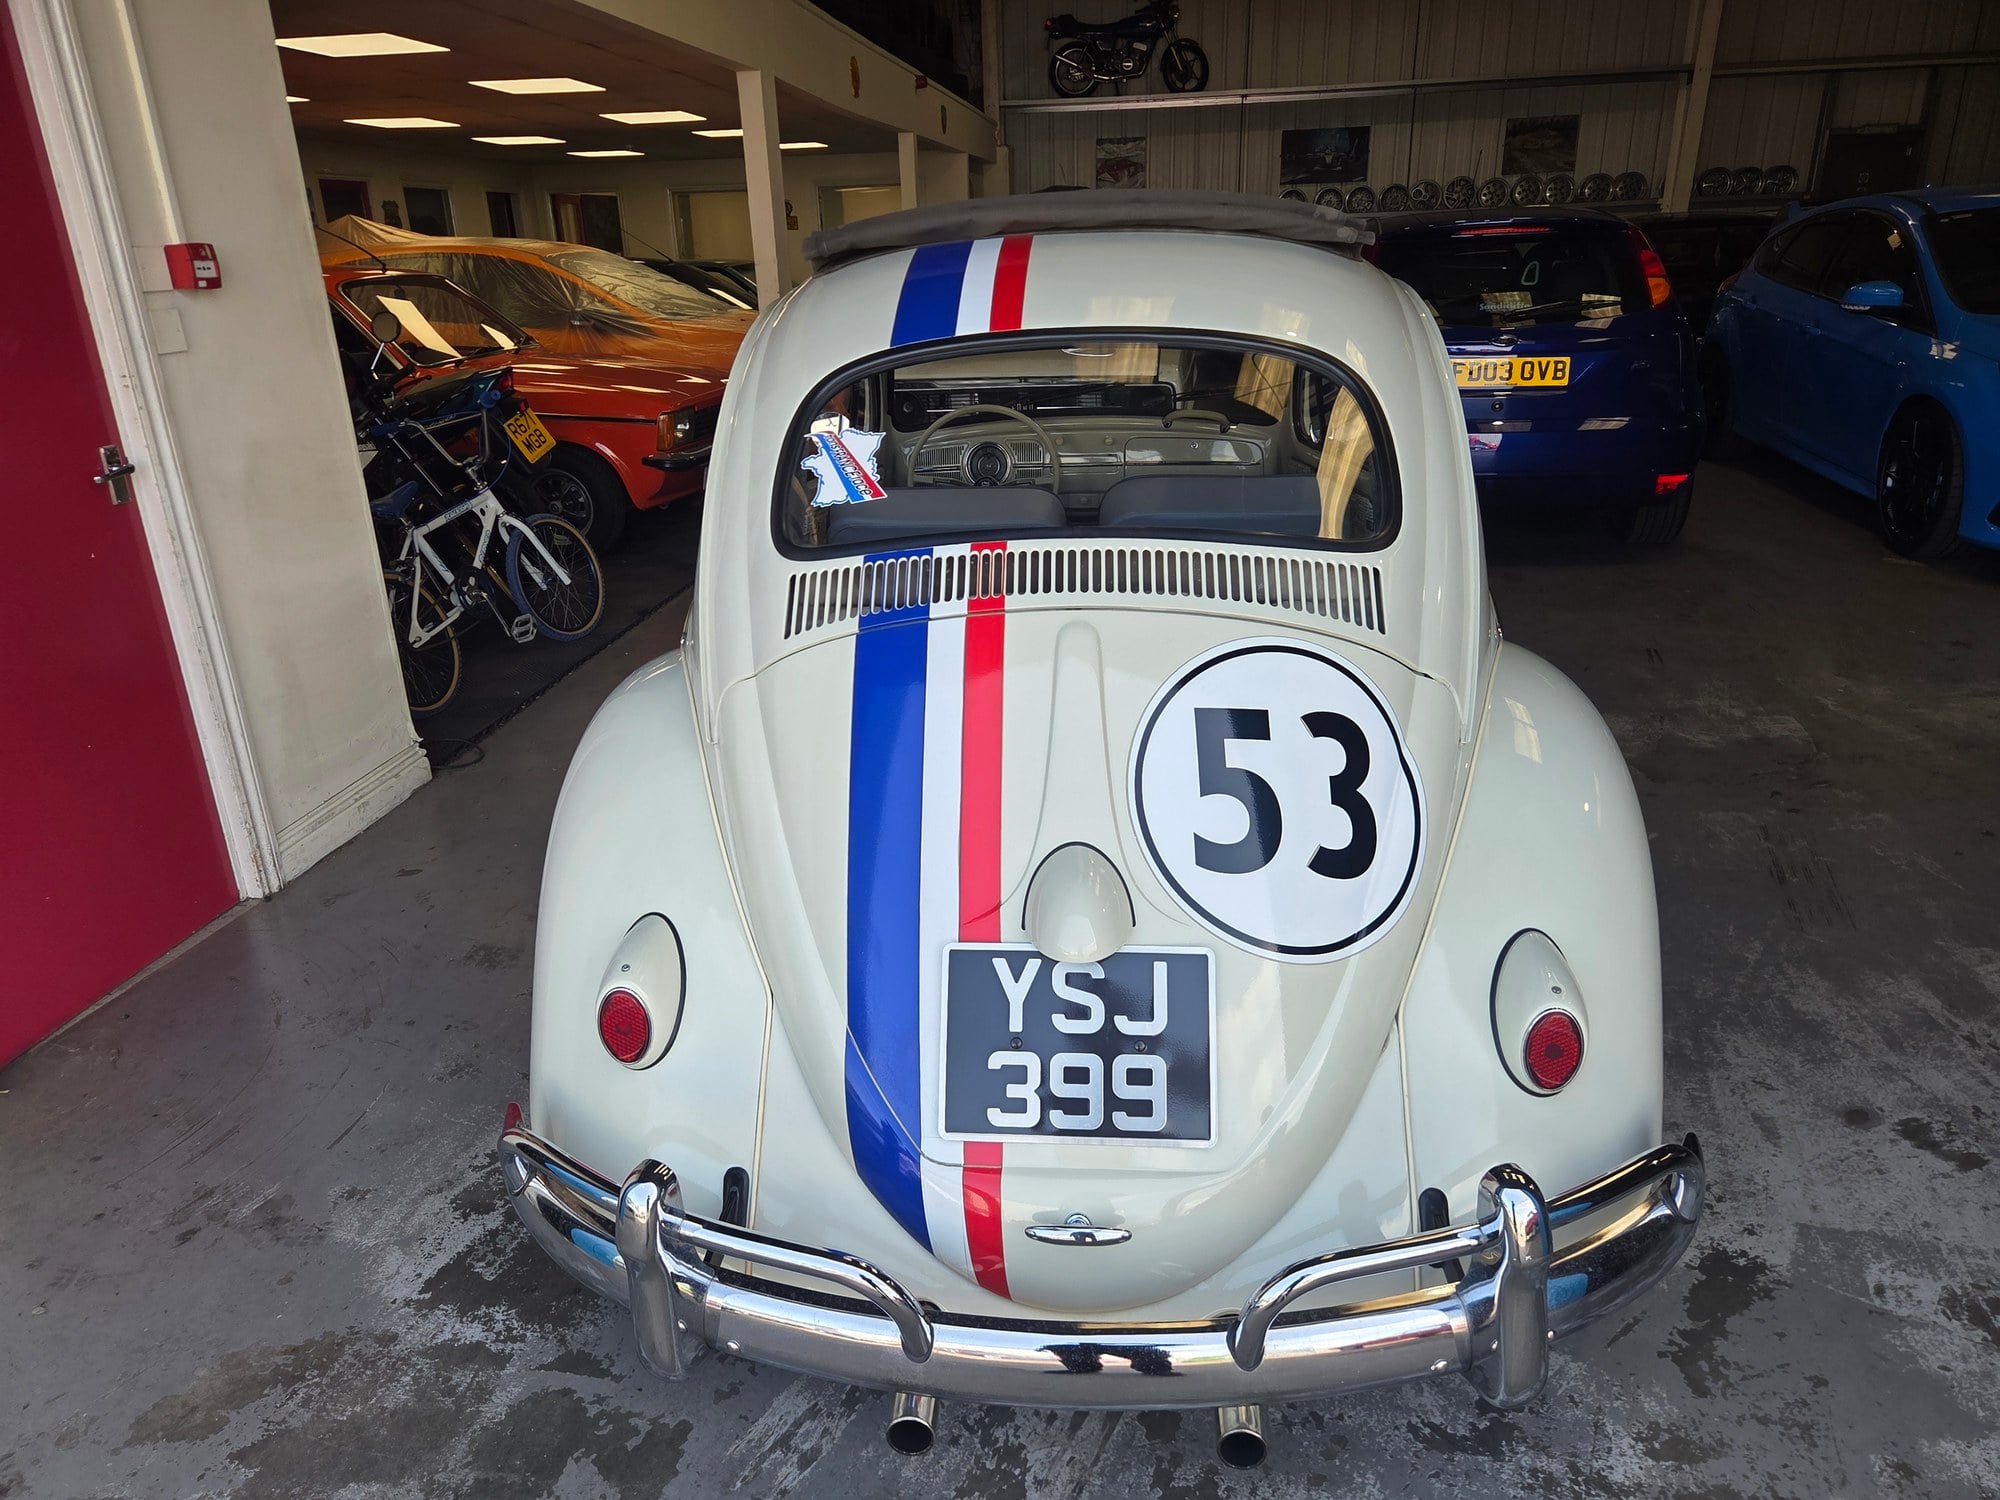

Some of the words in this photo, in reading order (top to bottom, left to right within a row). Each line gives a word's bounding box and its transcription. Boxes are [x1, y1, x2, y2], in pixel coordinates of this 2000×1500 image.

[1453, 360, 1513, 381] FD03
[1520, 360, 1567, 381] OVB
[521, 428, 547, 455] MGB
[1193, 707, 1378, 880] 53
[991, 957, 1168, 1036] YSJ
[987, 1050, 1168, 1132] 399
